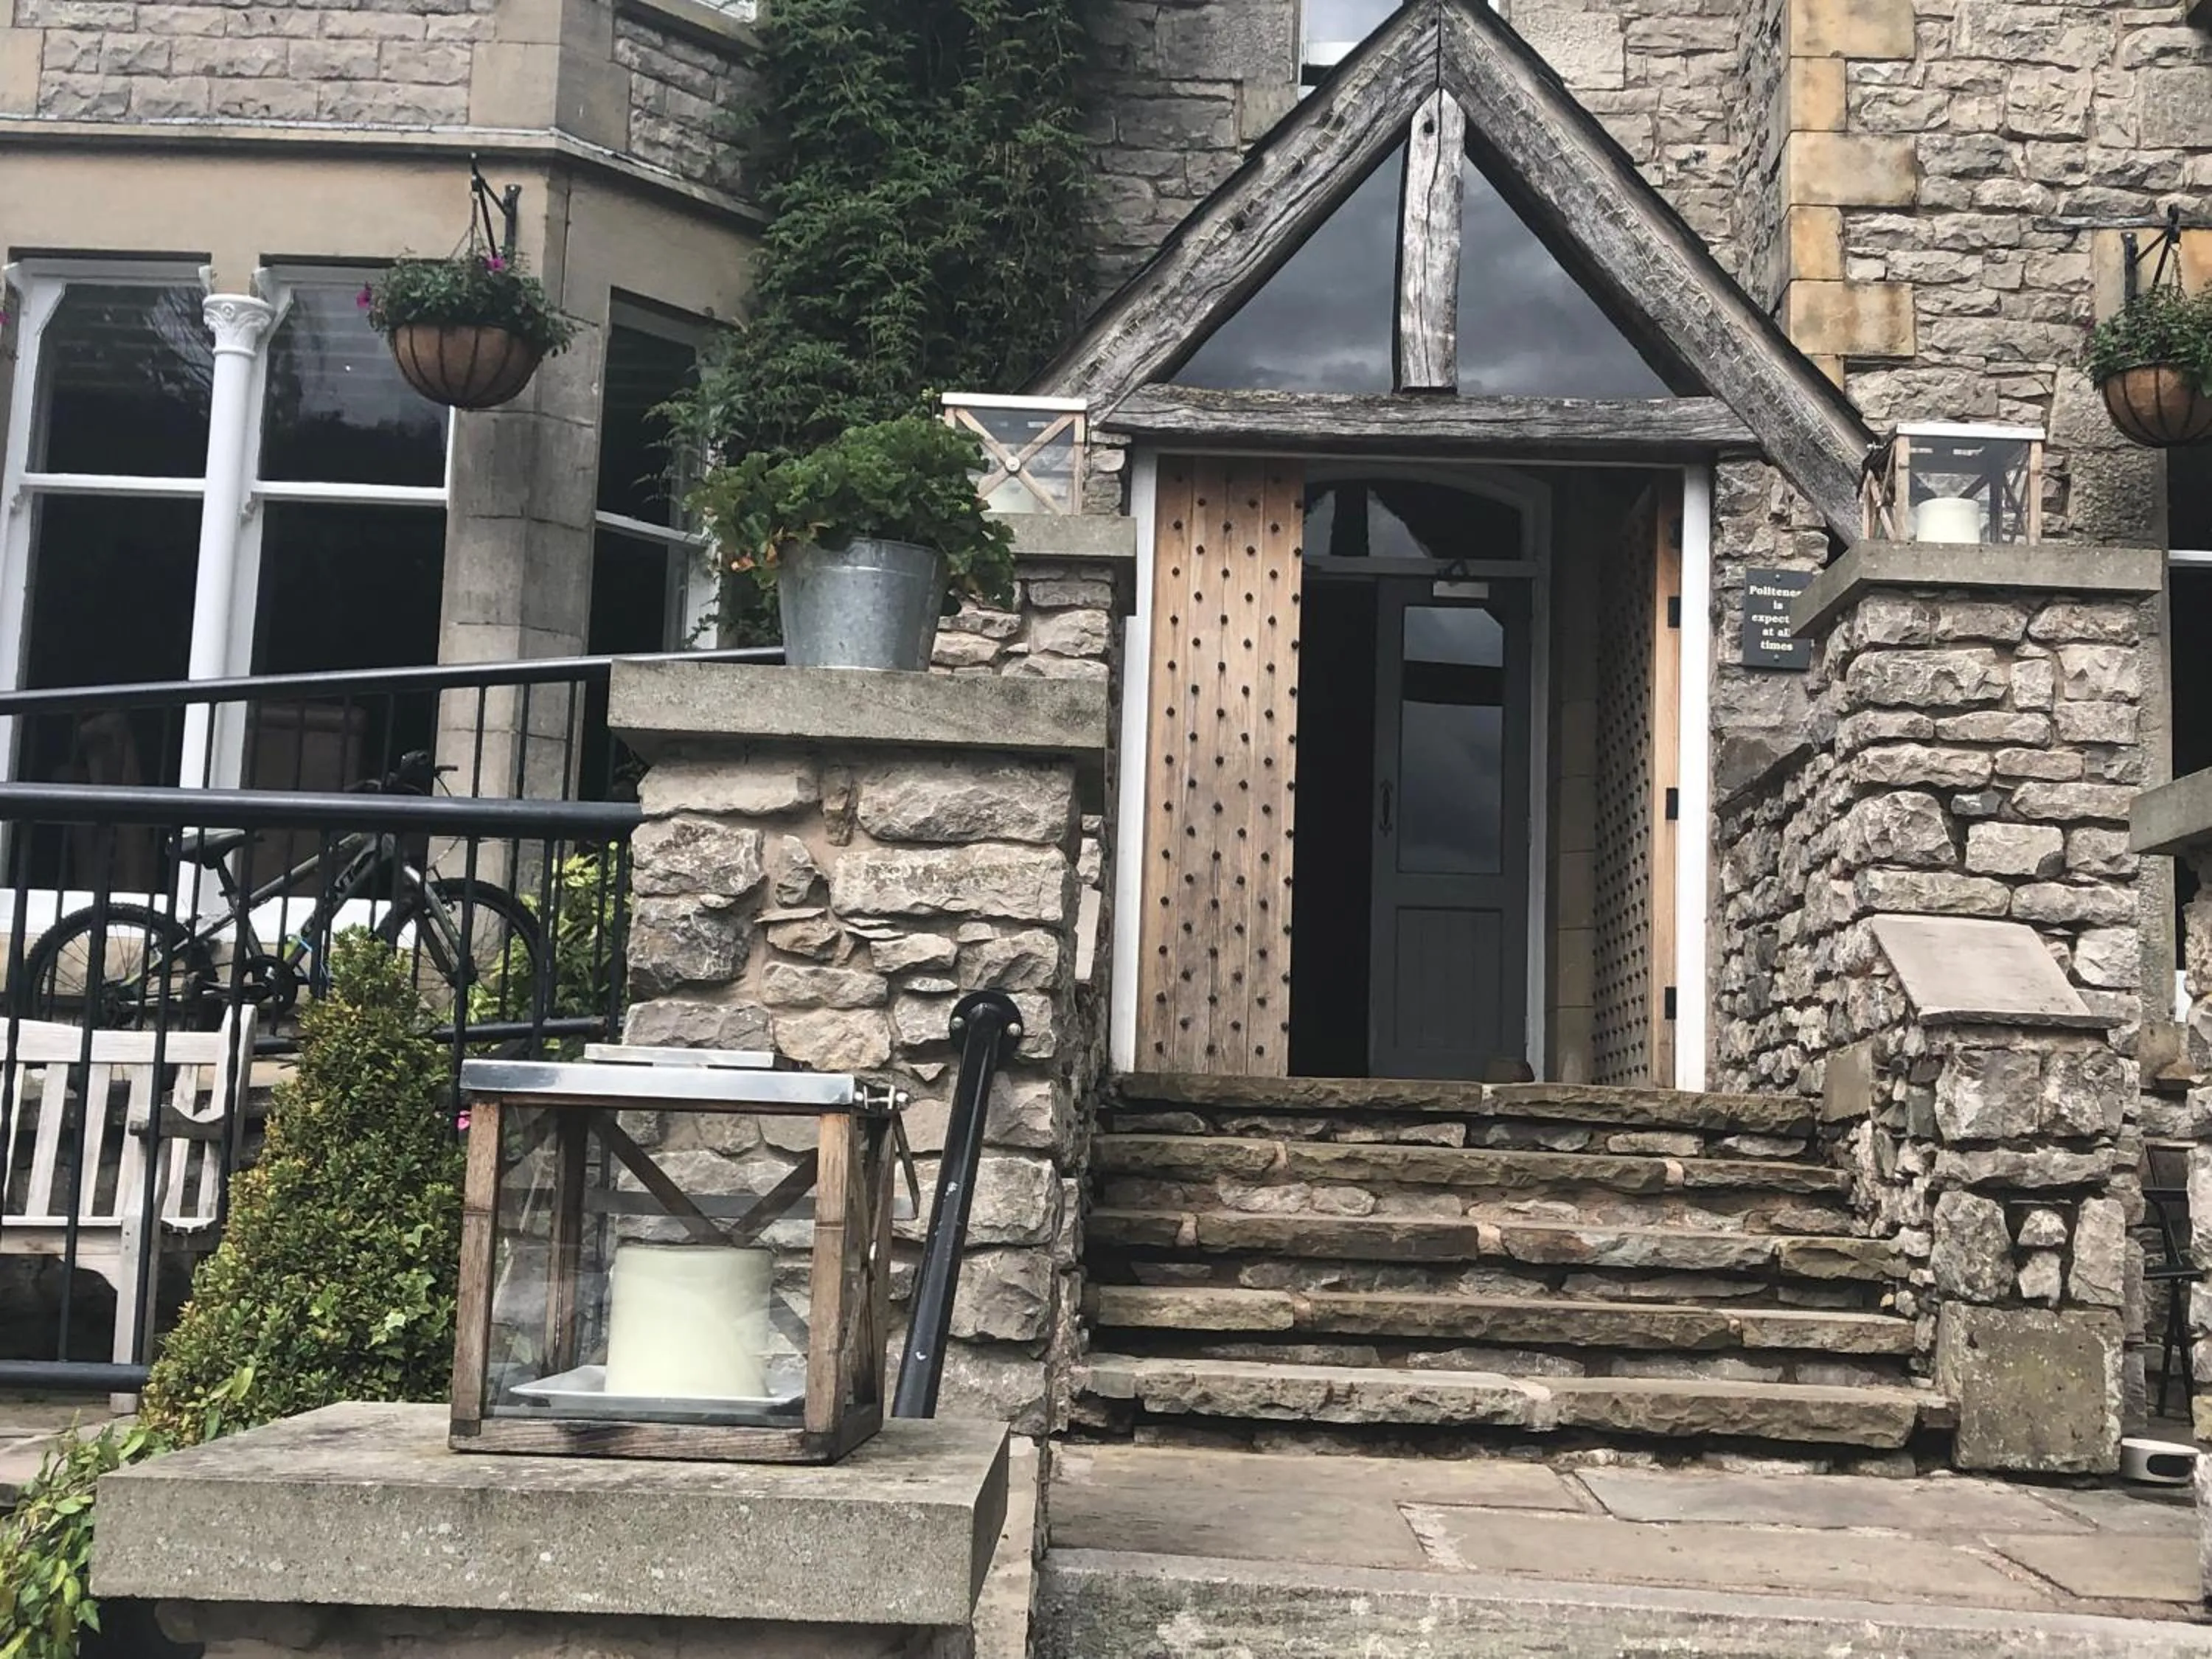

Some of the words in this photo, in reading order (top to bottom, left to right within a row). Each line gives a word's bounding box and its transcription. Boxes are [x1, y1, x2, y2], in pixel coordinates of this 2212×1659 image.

[1749, 585, 1802, 597] Politene
[1773, 599, 1783, 610] is
[1751, 614, 1790, 625] expect
[1762, 627, 1774, 636] at
[1760, 640, 1793, 651] times
